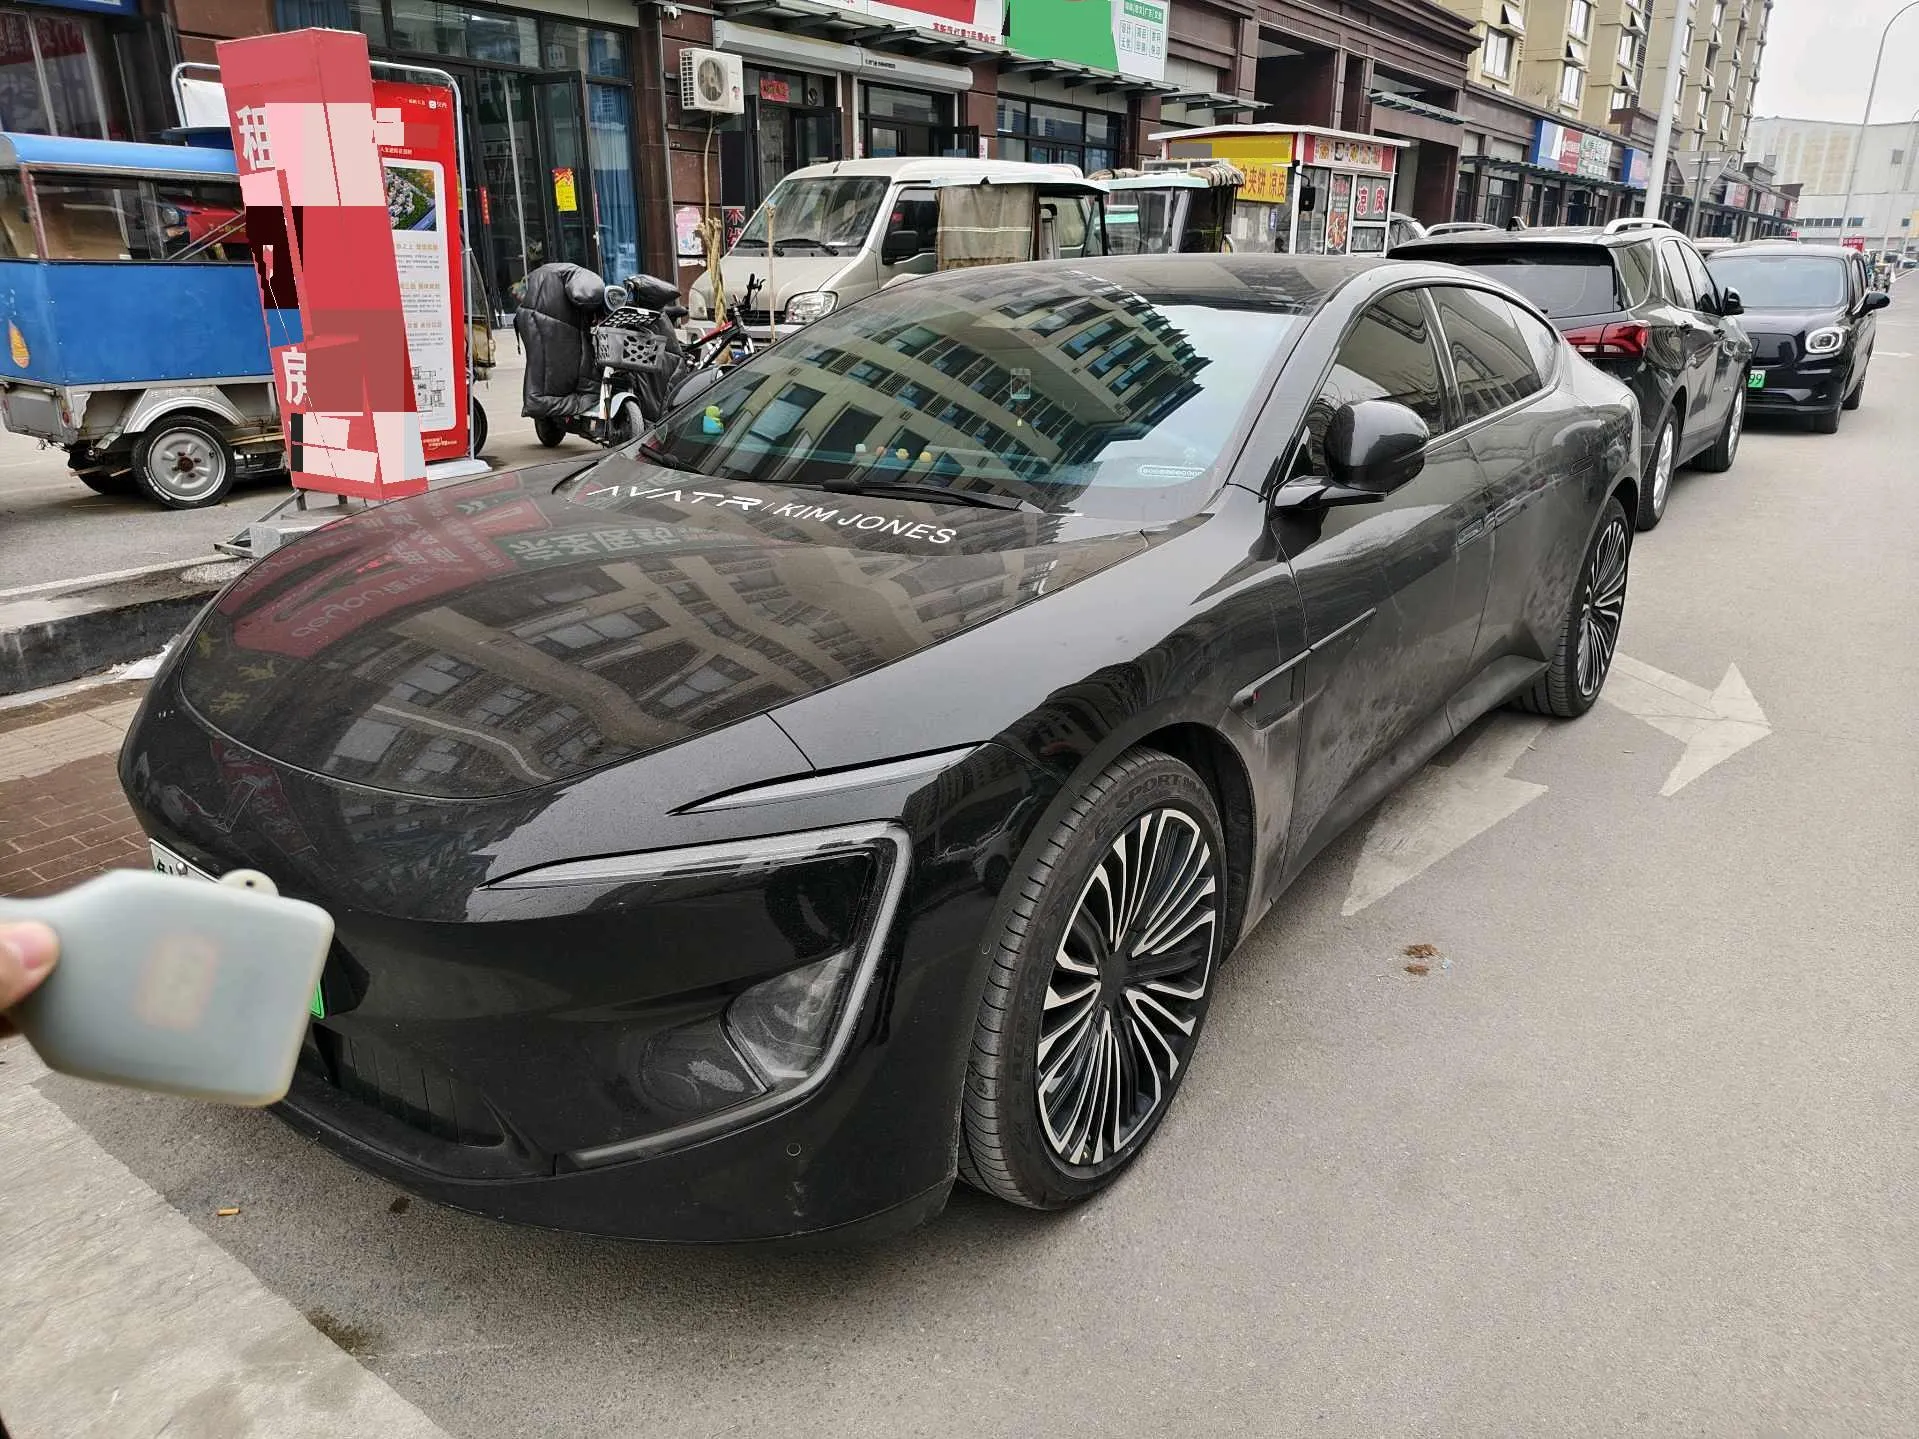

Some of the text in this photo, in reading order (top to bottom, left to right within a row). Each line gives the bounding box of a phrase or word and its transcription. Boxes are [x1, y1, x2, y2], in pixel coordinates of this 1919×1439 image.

[235, 105, 275, 171] 租
[1269, 170, 1285, 200] 凉皮
[1356, 186, 1386, 215] 凉皮
[586, 484, 957, 544] AVATR KIM JONES
